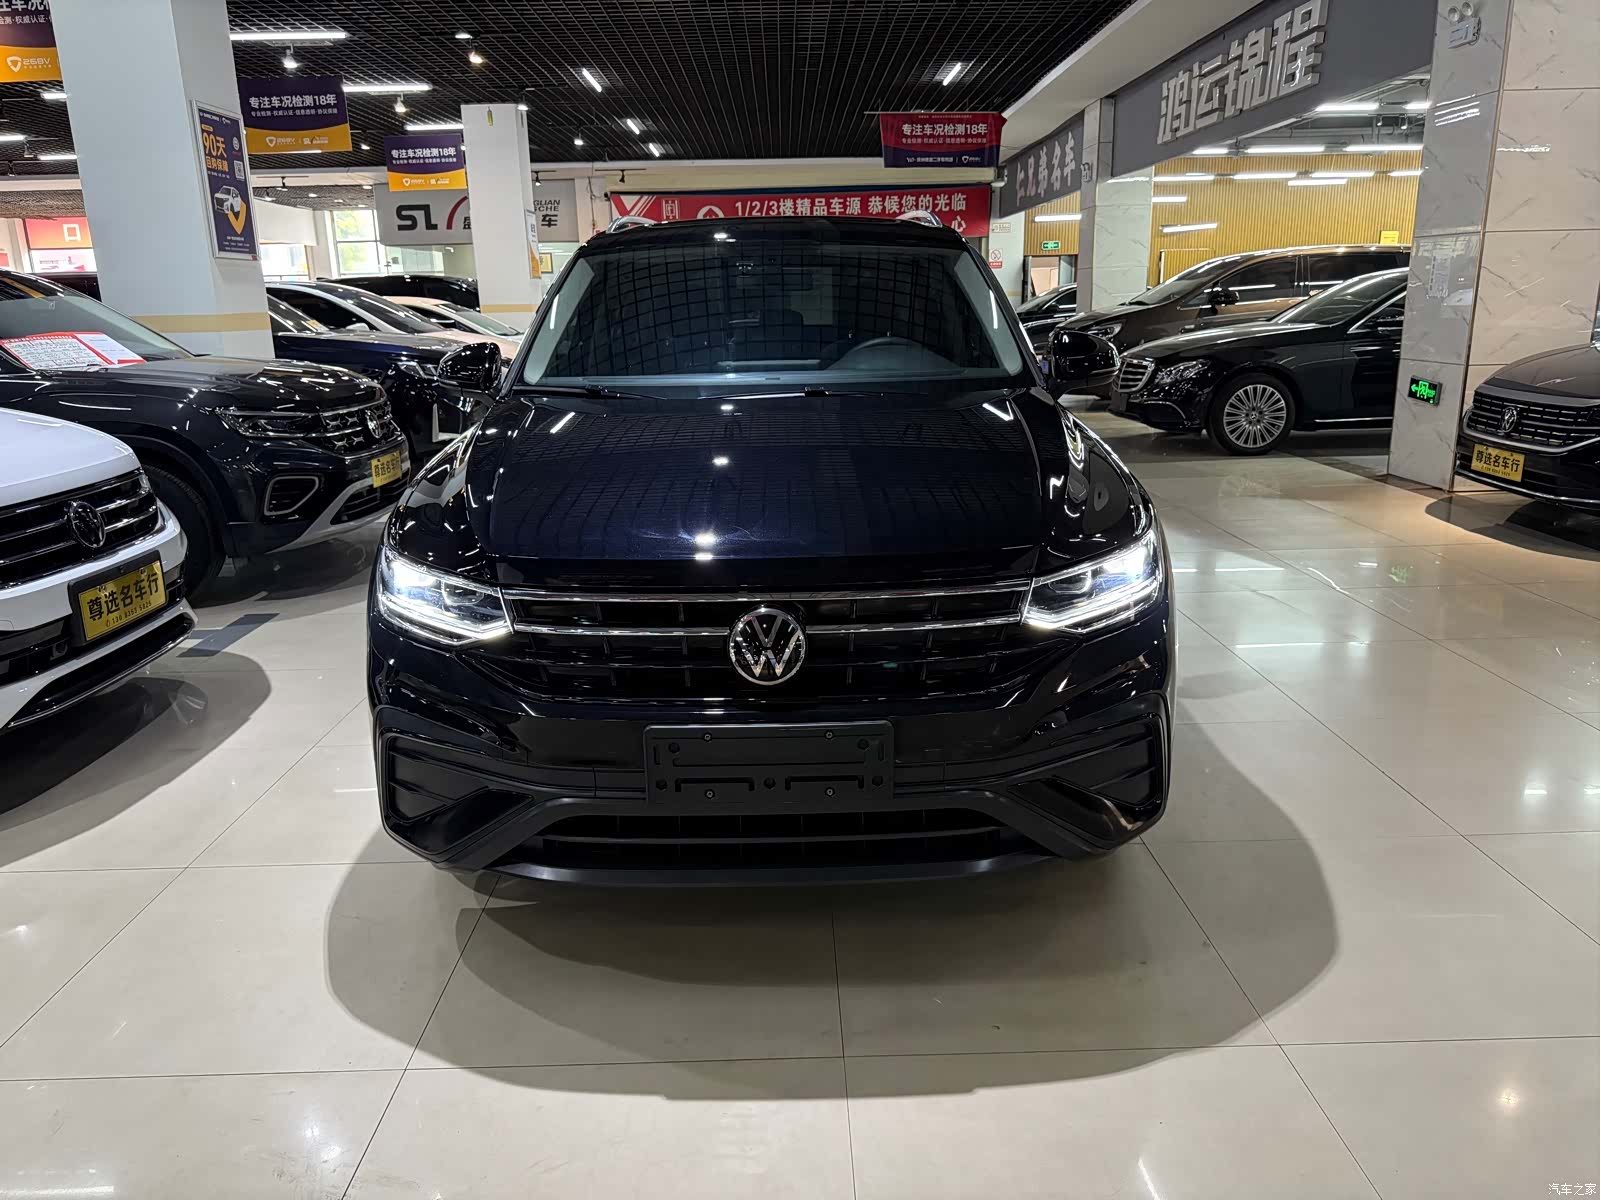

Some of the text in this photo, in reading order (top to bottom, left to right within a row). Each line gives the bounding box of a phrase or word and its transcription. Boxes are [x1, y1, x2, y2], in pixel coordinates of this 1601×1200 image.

[1157, 0, 1328, 144] 鸿运锦程
[249, 94, 337, 109] 专注车况检测18年
[902, 123, 988, 136] 专注车况检测18年
[203, 132, 227, 158] 90天
[391, 147, 457, 158] 专注车况检测18年
[735, 193, 967, 217] 1/2/3楼精品车源 恭候您的光临
[1476, 450, 1520, 472] 尊选名车行
[87, 573, 159, 621] 尊选名车行
